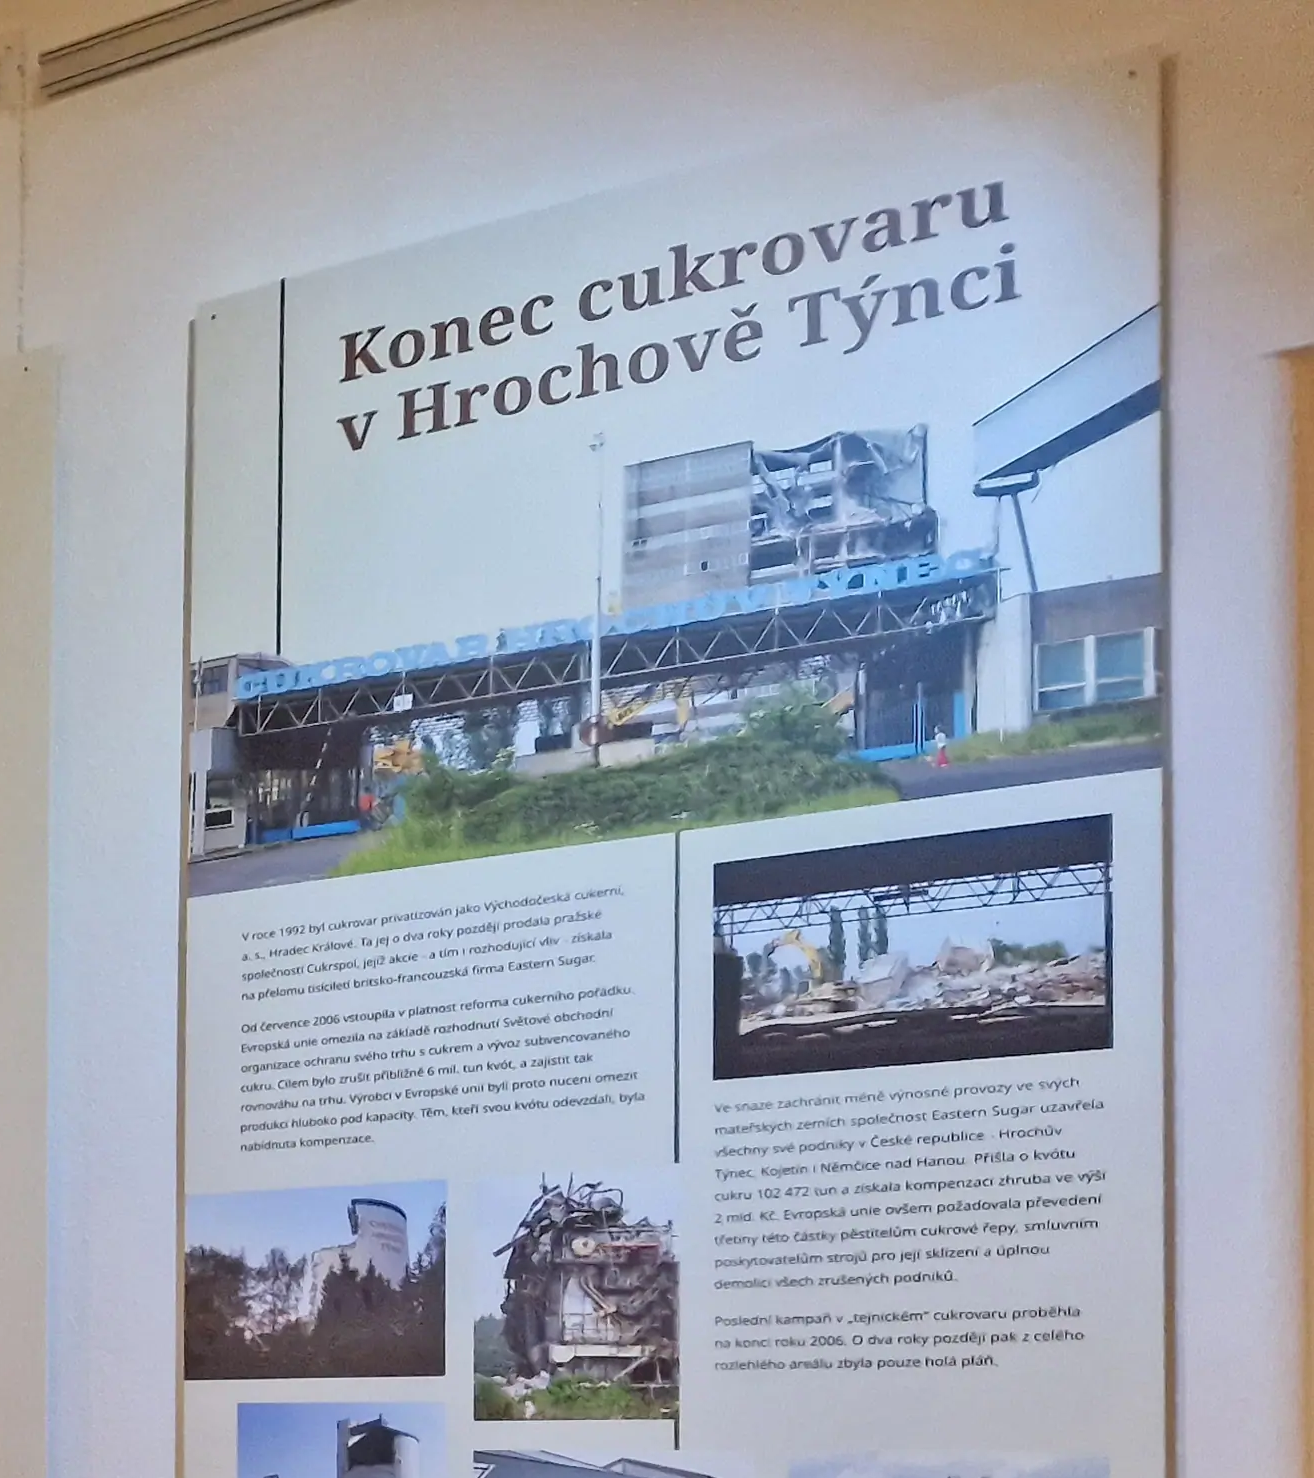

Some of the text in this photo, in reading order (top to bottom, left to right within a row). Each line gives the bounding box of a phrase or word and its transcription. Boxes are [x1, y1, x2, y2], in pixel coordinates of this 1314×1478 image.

[339, 180, 1009, 383] Konec cukrovaru
[337, 241, 1021, 452] v Hrochově Týnci
[241, 931, 249, 941] V
[252, 930, 276, 940] roce
[279, 924, 305, 937] 1992
[308, 922, 325, 935] byl
[328, 917, 377, 931] cukrovar
[381, 907, 452, 926] privatizován
[454, 904, 481, 918] jako
[269, 945, 309, 957] Hradec
[361, 936, 372, 947] Ta
[374, 935, 389, 948] jej
[392, 935, 400, 944] o
[403, 931, 424, 942] dva
[427, 927, 454, 940] roky
[503, 916, 550, 932] prodala
[554, 911, 601, 926] pražské
[389, 953, 418, 964] akcie
[429, 951, 435, 960] a
[439, 947, 459, 958] tím
[469, 937, 536, 954] rozhodující
[241, 992, 255, 1001] na
[472, 964, 504, 976] firma
[508, 959, 555, 972] Eastern
[241, 1022, 257, 1034] Od
[259, 1019, 310, 1032] července
[312, 1014, 340, 1026] 2006
[398, 1009, 406, 1017] v
[408, 1003, 457, 1019] platnost
[460, 998, 509, 1011] reforma
[241, 1039, 290, 1053] Evropská
[293, 1038, 317, 1048] unie
[321, 1032, 365, 1045] omezila
[368, 1032, 382, 1040] na
[433, 1018, 500, 1034] rozhodnutí
[553, 1008, 613, 1023] obchodní
[240, 1029, 630, 1074] organizace ochranu svého trhu s cukrem a subvencovaného
[312, 1053, 592, 1088] bylo 6 tun a tak
[302, 1098, 315, 1107] na
[394, 1091, 402, 1100] v
[405, 1085, 458, 1099] Evropské
[487, 1080, 508, 1094] byli
[512, 1079, 545, 1092] proto
[291, 1116, 337, 1128] hluboko
[340, 1112, 362, 1127] pod
[482, 1103, 511, 1113] svou
[513, 1099, 548, 1110] kvótu
